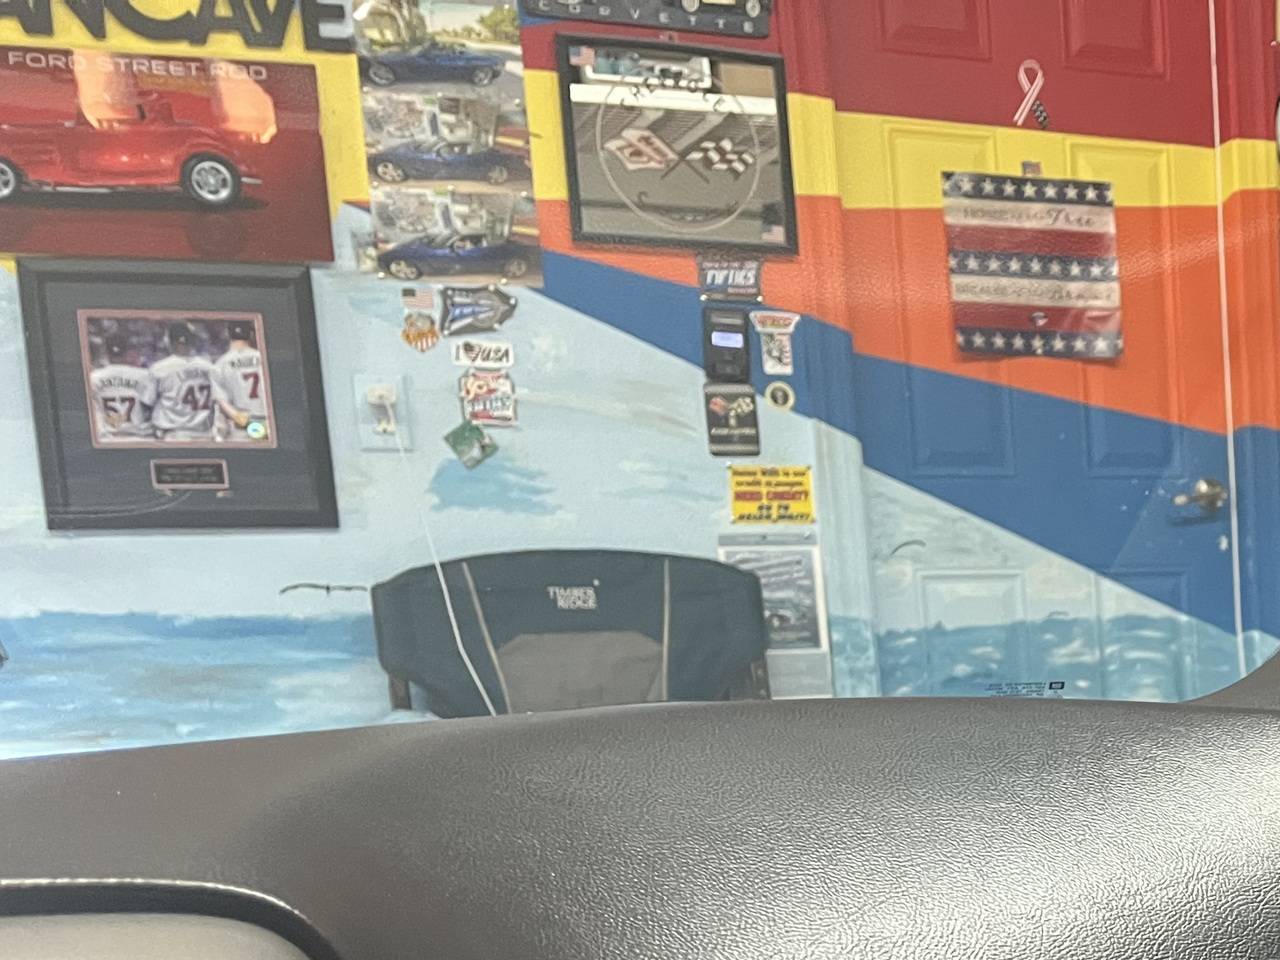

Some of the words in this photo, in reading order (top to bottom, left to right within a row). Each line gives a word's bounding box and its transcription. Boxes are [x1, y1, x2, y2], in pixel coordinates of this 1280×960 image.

[8, 51, 87, 71] FORD
[96, 55, 203, 77] STREET
[181, 384, 213, 411] 47
[242, 371, 260, 399] 7
